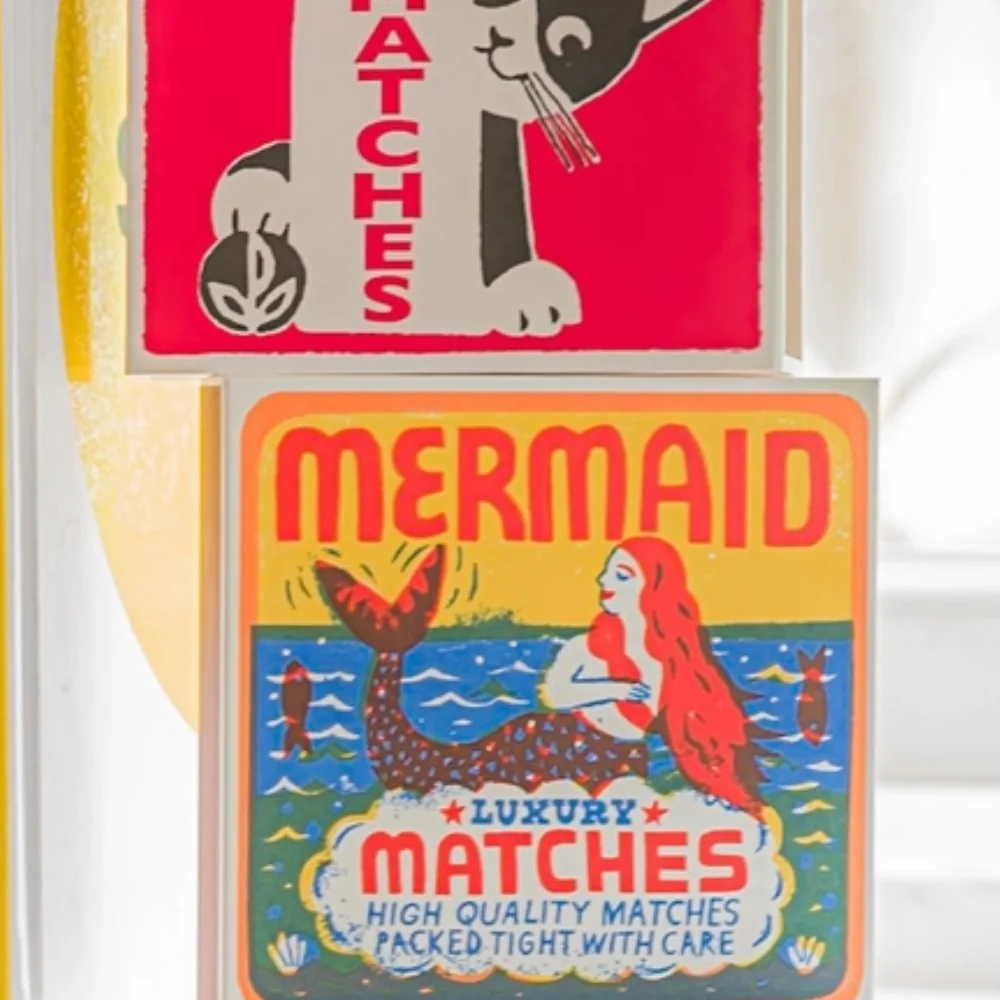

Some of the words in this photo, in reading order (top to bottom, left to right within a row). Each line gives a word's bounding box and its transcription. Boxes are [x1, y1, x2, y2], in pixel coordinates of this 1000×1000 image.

[350, 0, 432, 323] ATCHES
[273, 423, 832, 549] MERMAID
[470, 799, 638, 826] LUXURY
[360, 829, 749, 896] MATCHES
[366, 900, 442, 926] HIGH
[456, 899, 590, 927] QUALITY
[601, 898, 741, 926] MATCHES
[374, 930, 484, 957] PACKED
[490, 929, 576, 955] TIGHT
[582, 930, 654, 955] WITH
[661, 930, 735, 955] CARE
